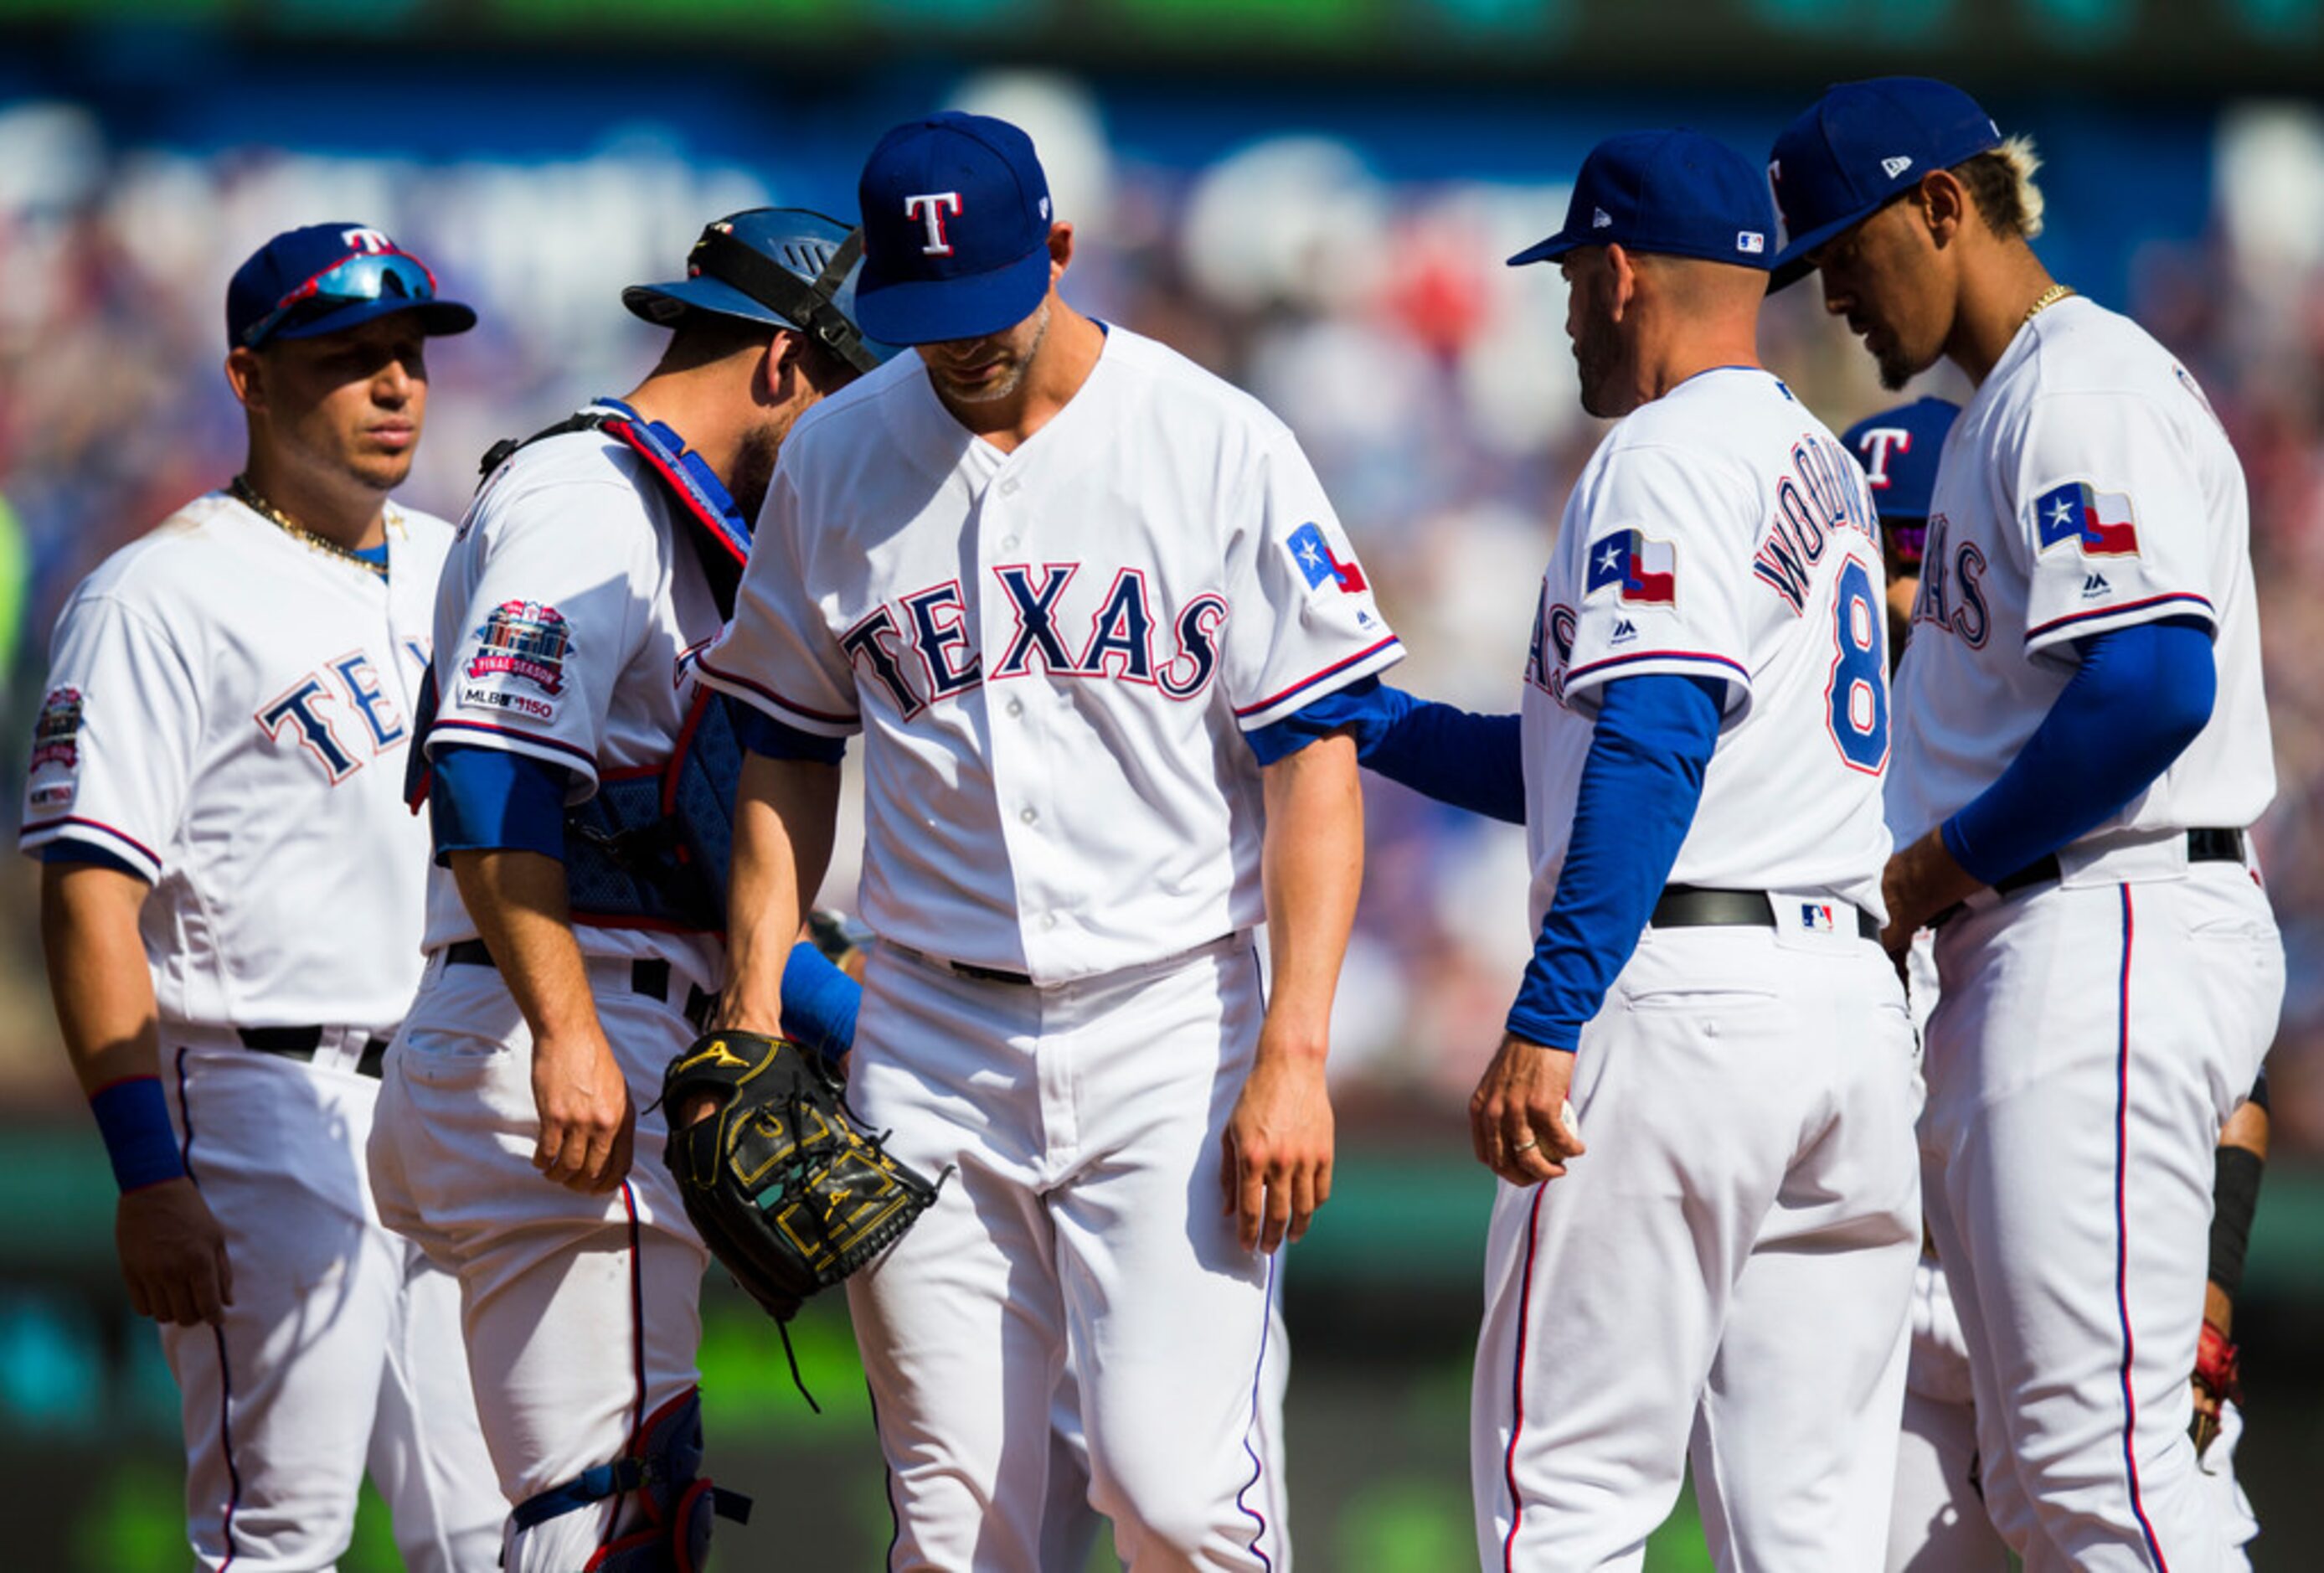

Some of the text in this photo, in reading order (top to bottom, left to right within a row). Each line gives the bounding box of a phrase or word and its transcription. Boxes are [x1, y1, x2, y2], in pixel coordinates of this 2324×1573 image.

[905, 191, 962, 256] T
[1851, 428, 1912, 488] T
[479, 658, 554, 684] FINAL SEASON
[837, 563, 1229, 723] TEXAS
[1824, 552, 1892, 777] 8
[465, 689, 501, 704] MLB
